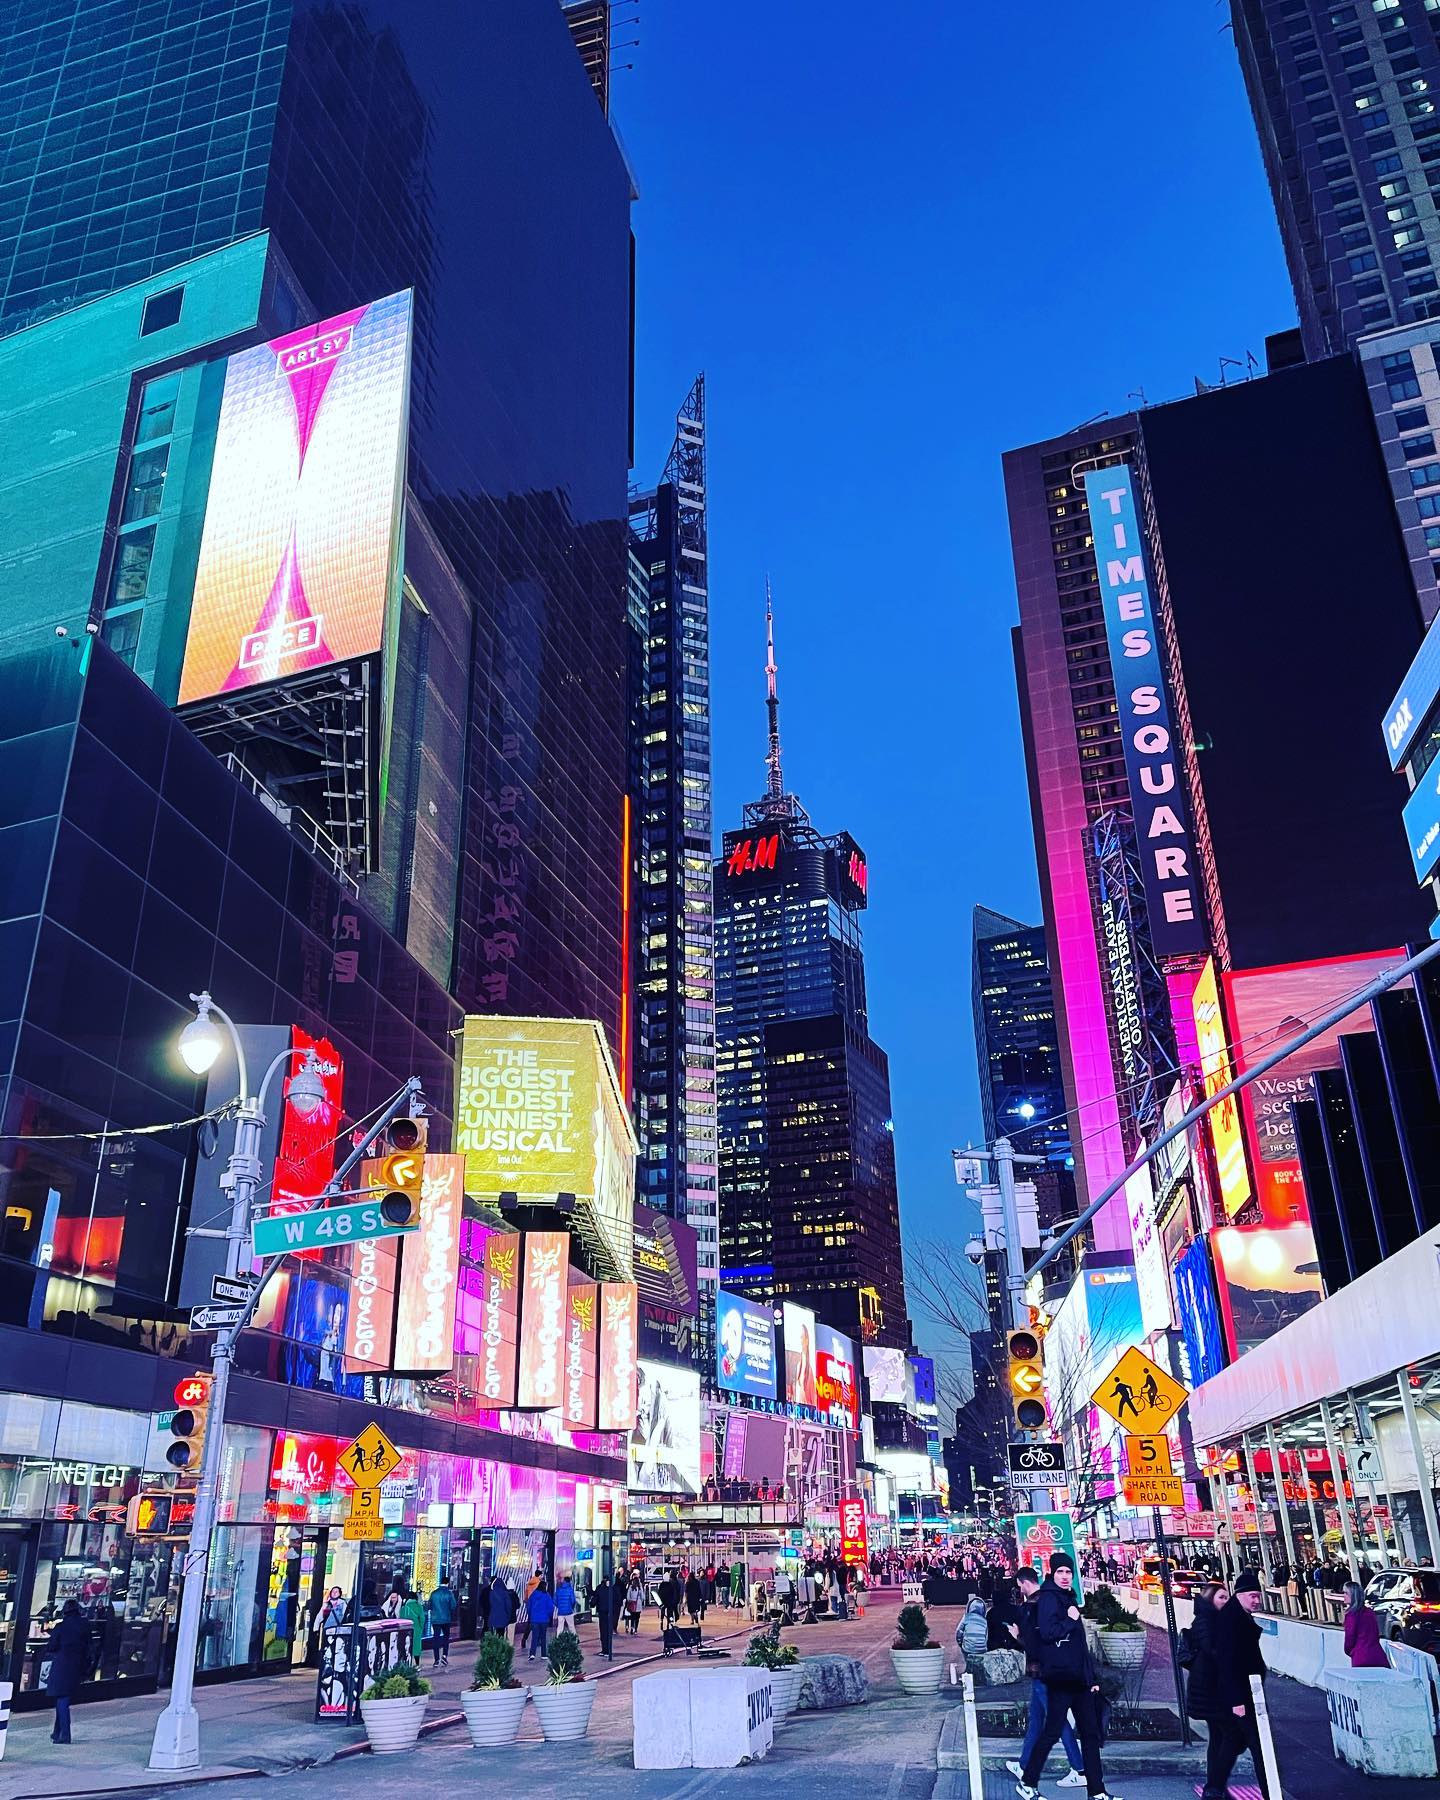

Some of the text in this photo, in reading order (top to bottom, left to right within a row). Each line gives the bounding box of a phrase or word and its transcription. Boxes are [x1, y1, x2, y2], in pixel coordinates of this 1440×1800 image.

[1101, 488, 1193, 923] TIMES SQUARE
[1388, 697, 1413, 750] DAX
[727, 834, 778, 876] H&M
[1102, 899, 1136, 1076] AMERICAN EAGLE
[1116, 919, 1141, 1044] OUTFITTERS
[1255, 1077, 1305, 1096] West
[285, 1222, 304, 1243] W
[316, 1213, 352, 1237] 48
[220, 1285, 234, 1295] ONE
[199, 1311, 243, 1322] ONE WA
[1139, 1440, 1156, 1461] 5
[1014, 1472, 1065, 1484] BIKE LANE
[1126, 1480, 1180, 1491] SHARE THE
[361, 1492, 372, 1507] 5
[1140, 1492, 1168, 1502] ROAD
[347, 1520, 381, 1528] SHARE THE
[845, 1504, 862, 1538] tkts
